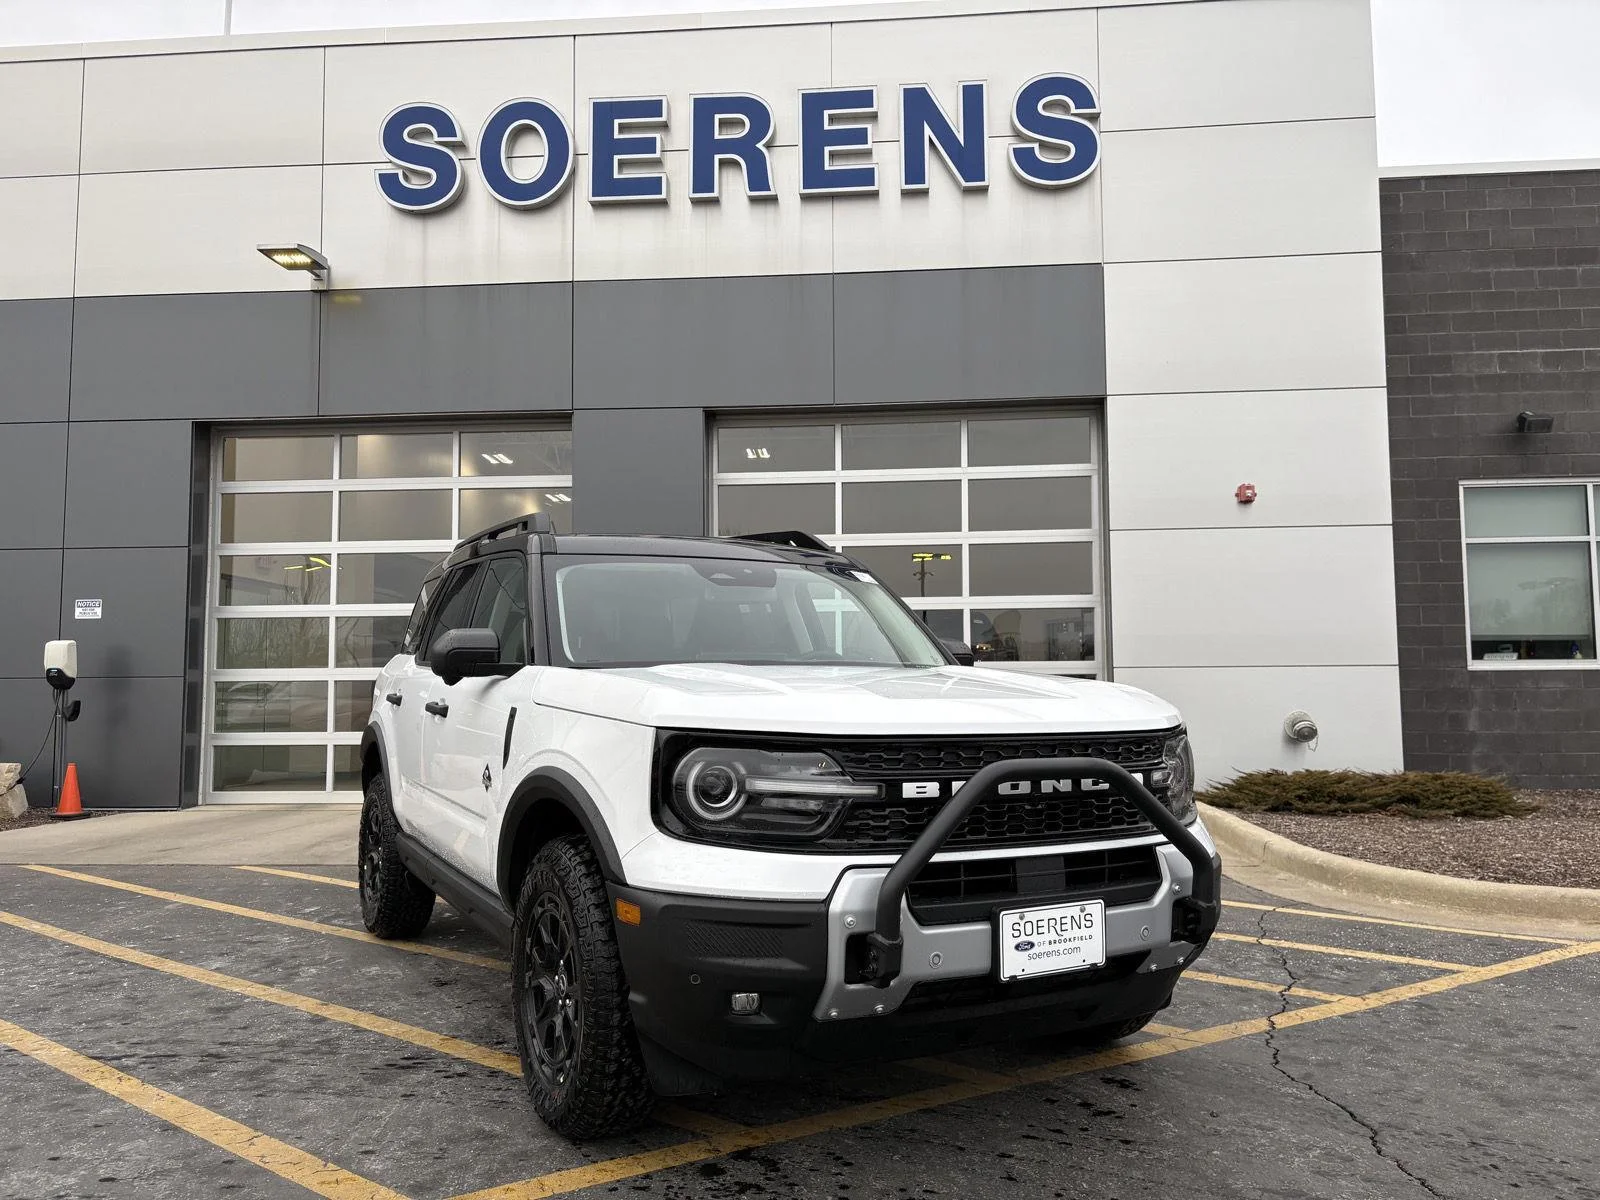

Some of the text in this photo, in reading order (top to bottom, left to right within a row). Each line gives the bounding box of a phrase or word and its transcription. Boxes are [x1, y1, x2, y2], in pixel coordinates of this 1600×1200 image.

[375, 72, 1101, 214] SOERENS
[902, 773, 1144, 798] BONC
[1011, 913, 1094, 938] SOERENS
[1048, 934, 1093, 946] BROOKFIELD
[1027, 946, 1081, 960] soerens.com
